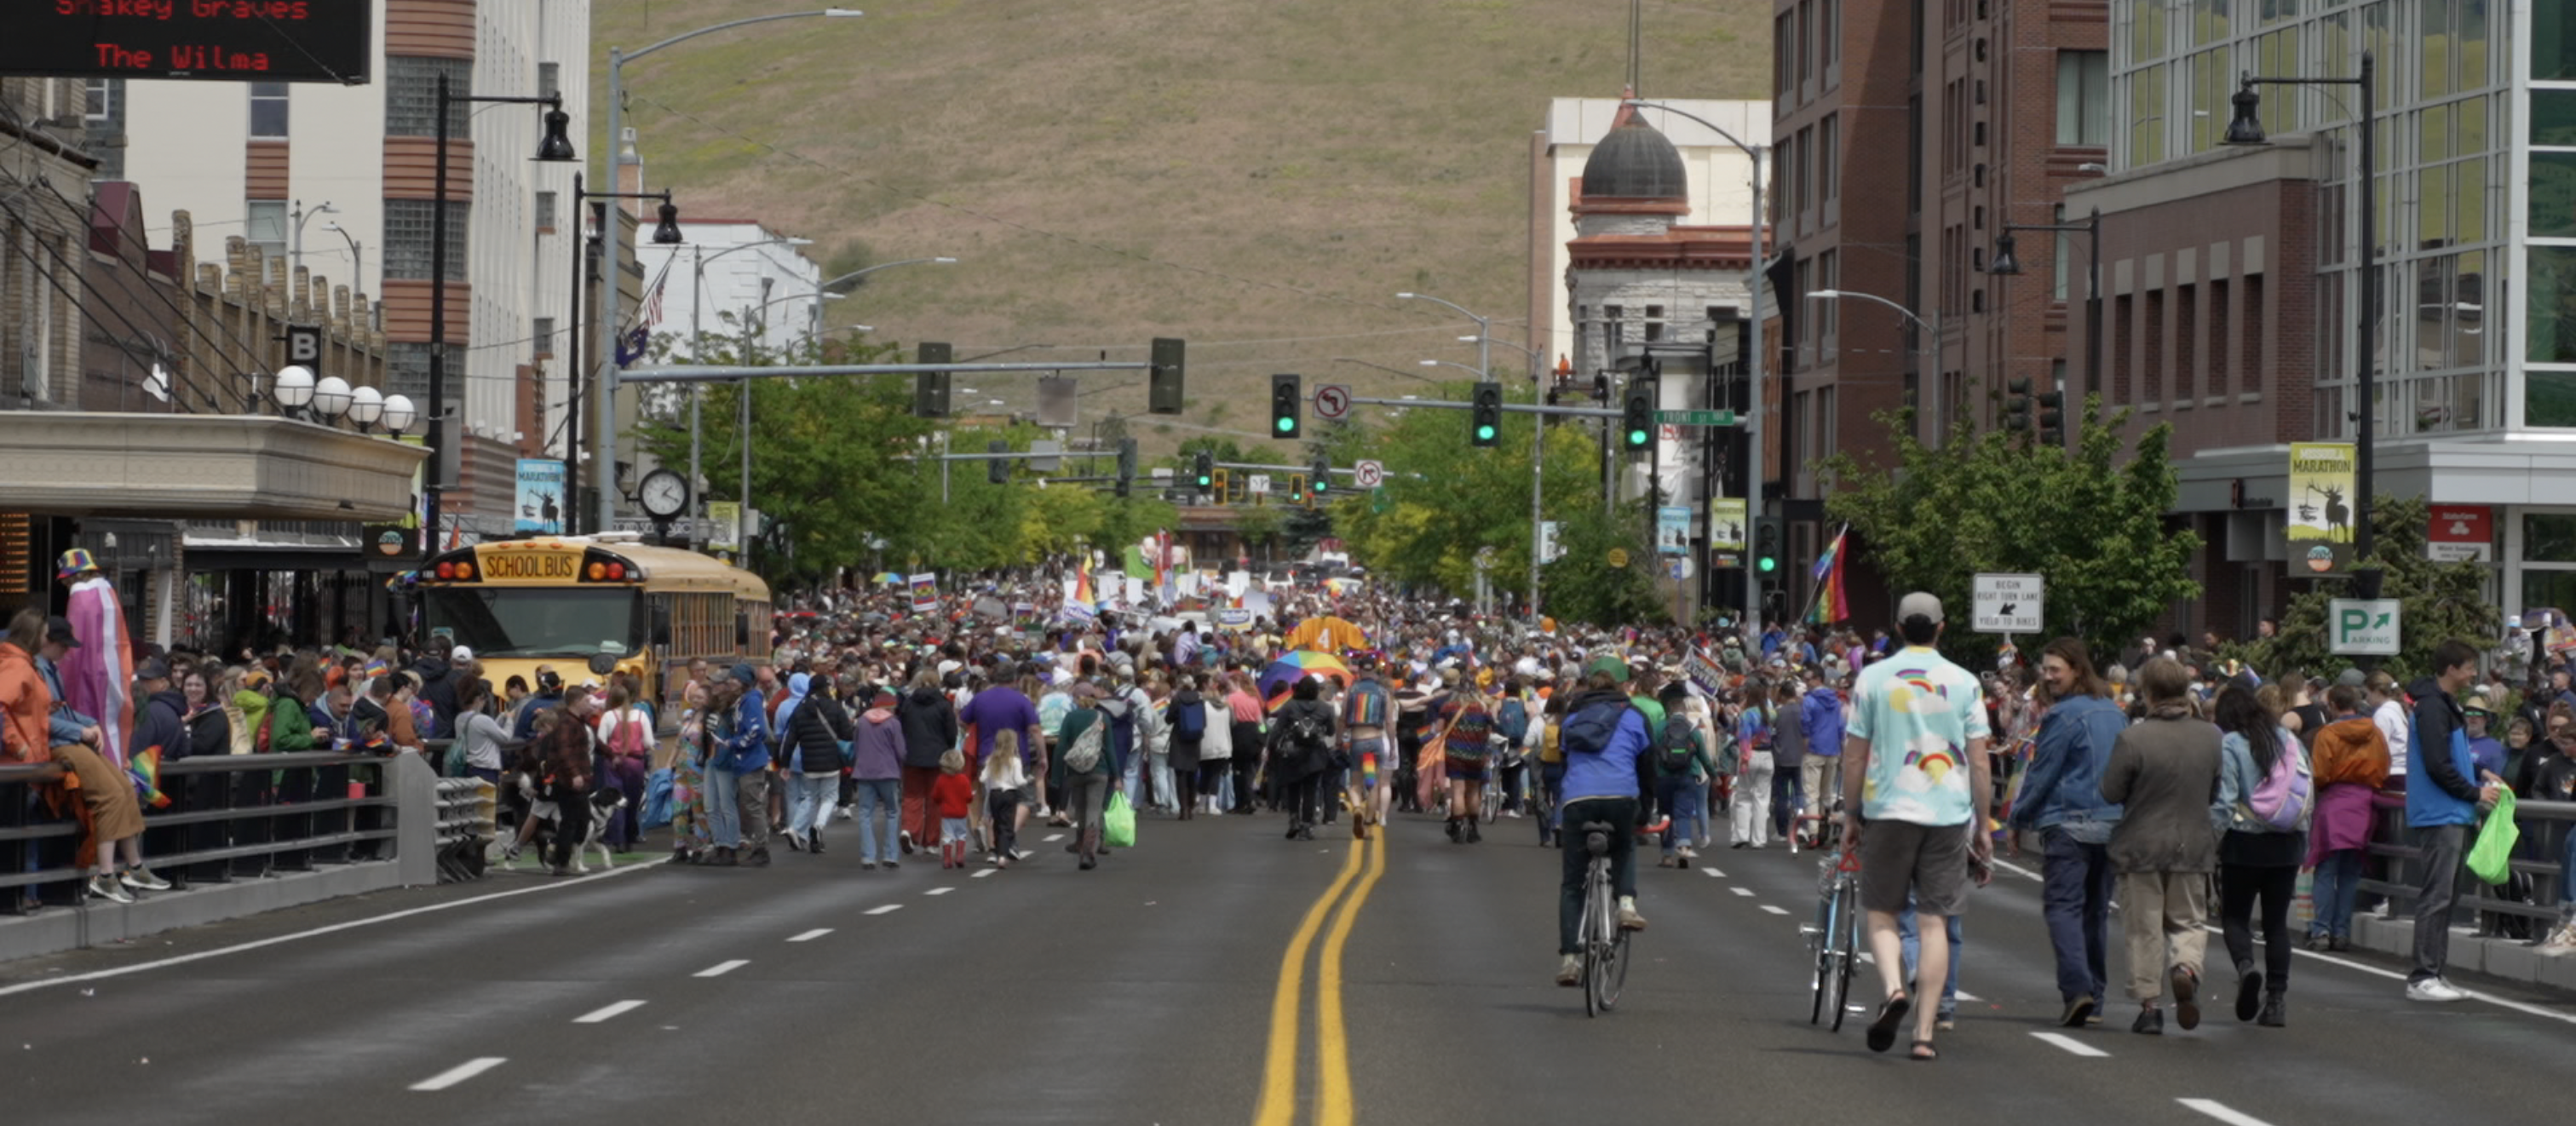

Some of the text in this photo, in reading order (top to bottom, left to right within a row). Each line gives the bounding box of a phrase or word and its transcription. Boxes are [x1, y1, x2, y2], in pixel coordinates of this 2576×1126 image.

[193, 0, 309, 19] Graves
[95, 43, 269, 70] The Wilma
[1664, 411, 1691, 423] FRONT
[1698, 414, 1707, 423] ST
[2292, 459, 2351, 473] MARATHON
[486, 555, 573, 577] SCHOOL BUS
[1996, 580, 2021, 589] BEGIN
[1977, 591, 2038, 601] RIGHT TURN LANE
[1979, 617, 2037, 627] YIELD TO BIKES
[1317, 628, 1331, 649] 4
